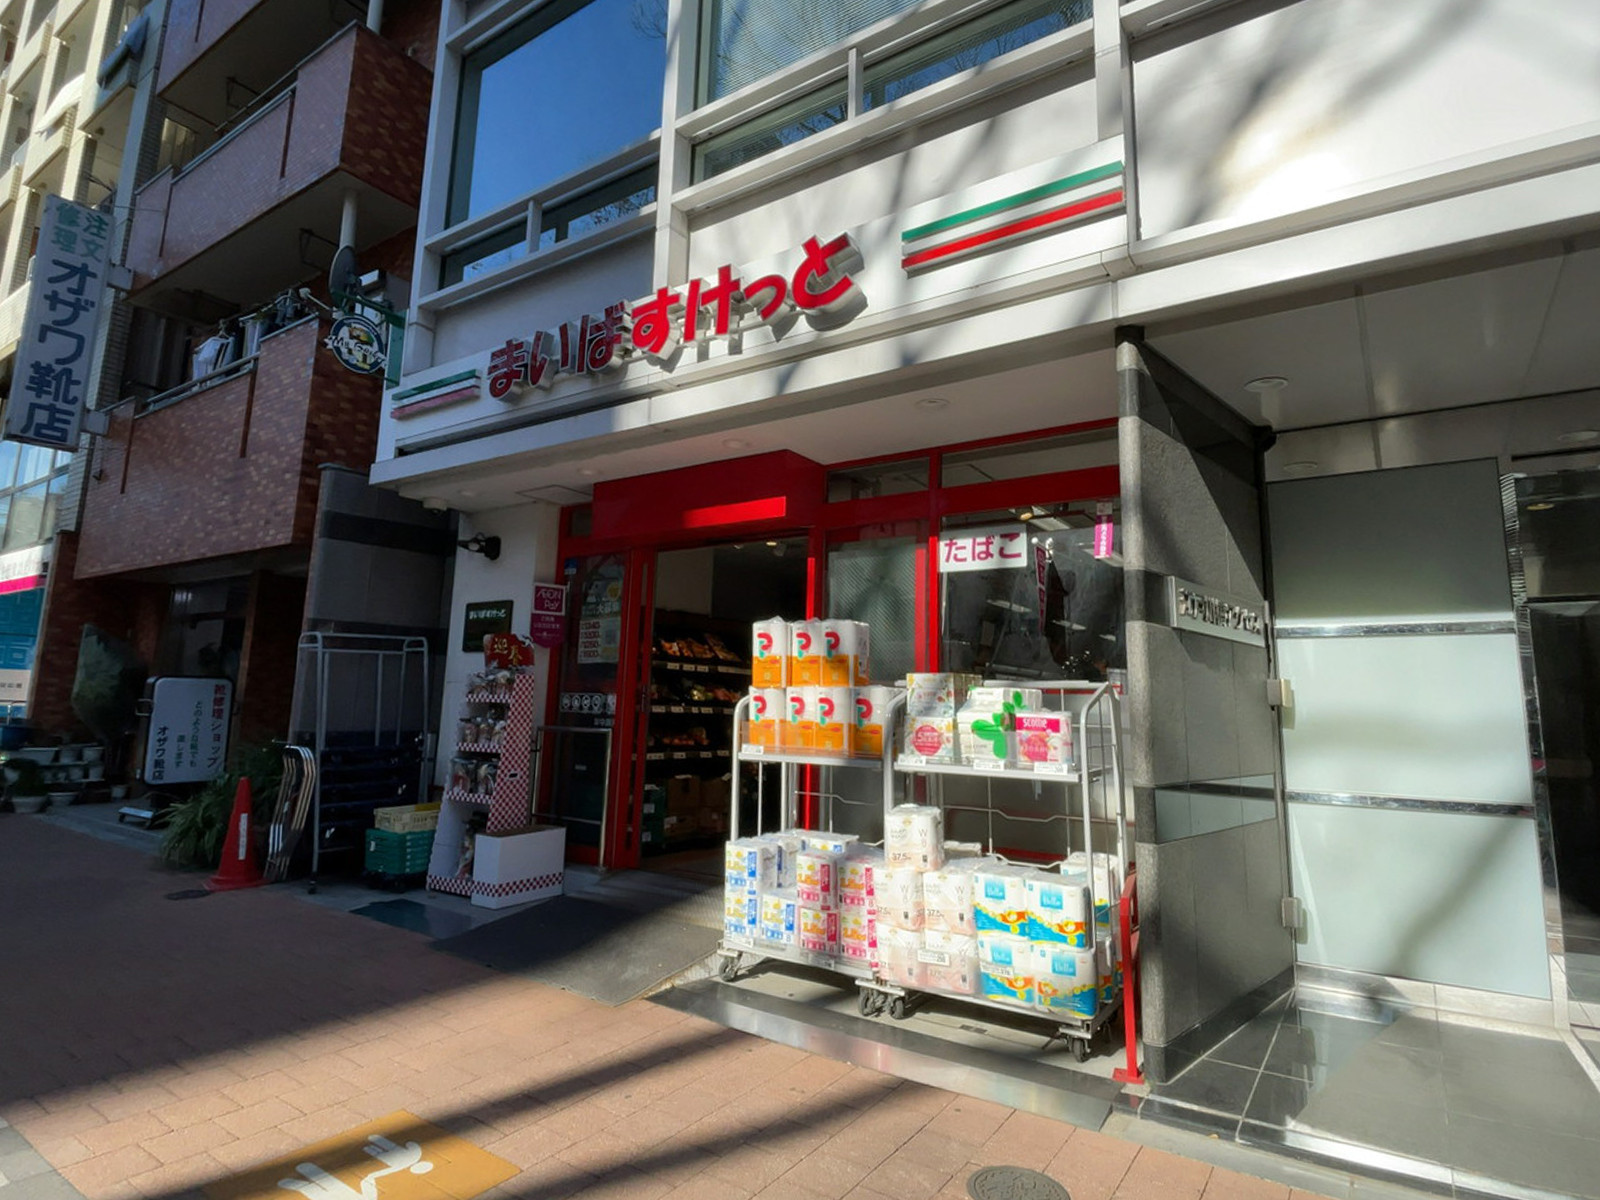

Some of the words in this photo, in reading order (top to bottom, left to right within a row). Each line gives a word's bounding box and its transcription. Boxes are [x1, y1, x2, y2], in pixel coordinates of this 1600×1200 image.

[52, 202, 82, 254] 修理
[81, 211, 109, 263] 注文
[486, 231, 856, 400] まいばすけっと
[20, 258, 98, 444] オザワ靴店
[944, 532, 1022, 563] たばこ
[543, 600, 561, 611] Pay
[153, 726, 168, 780] オザワ靴店
